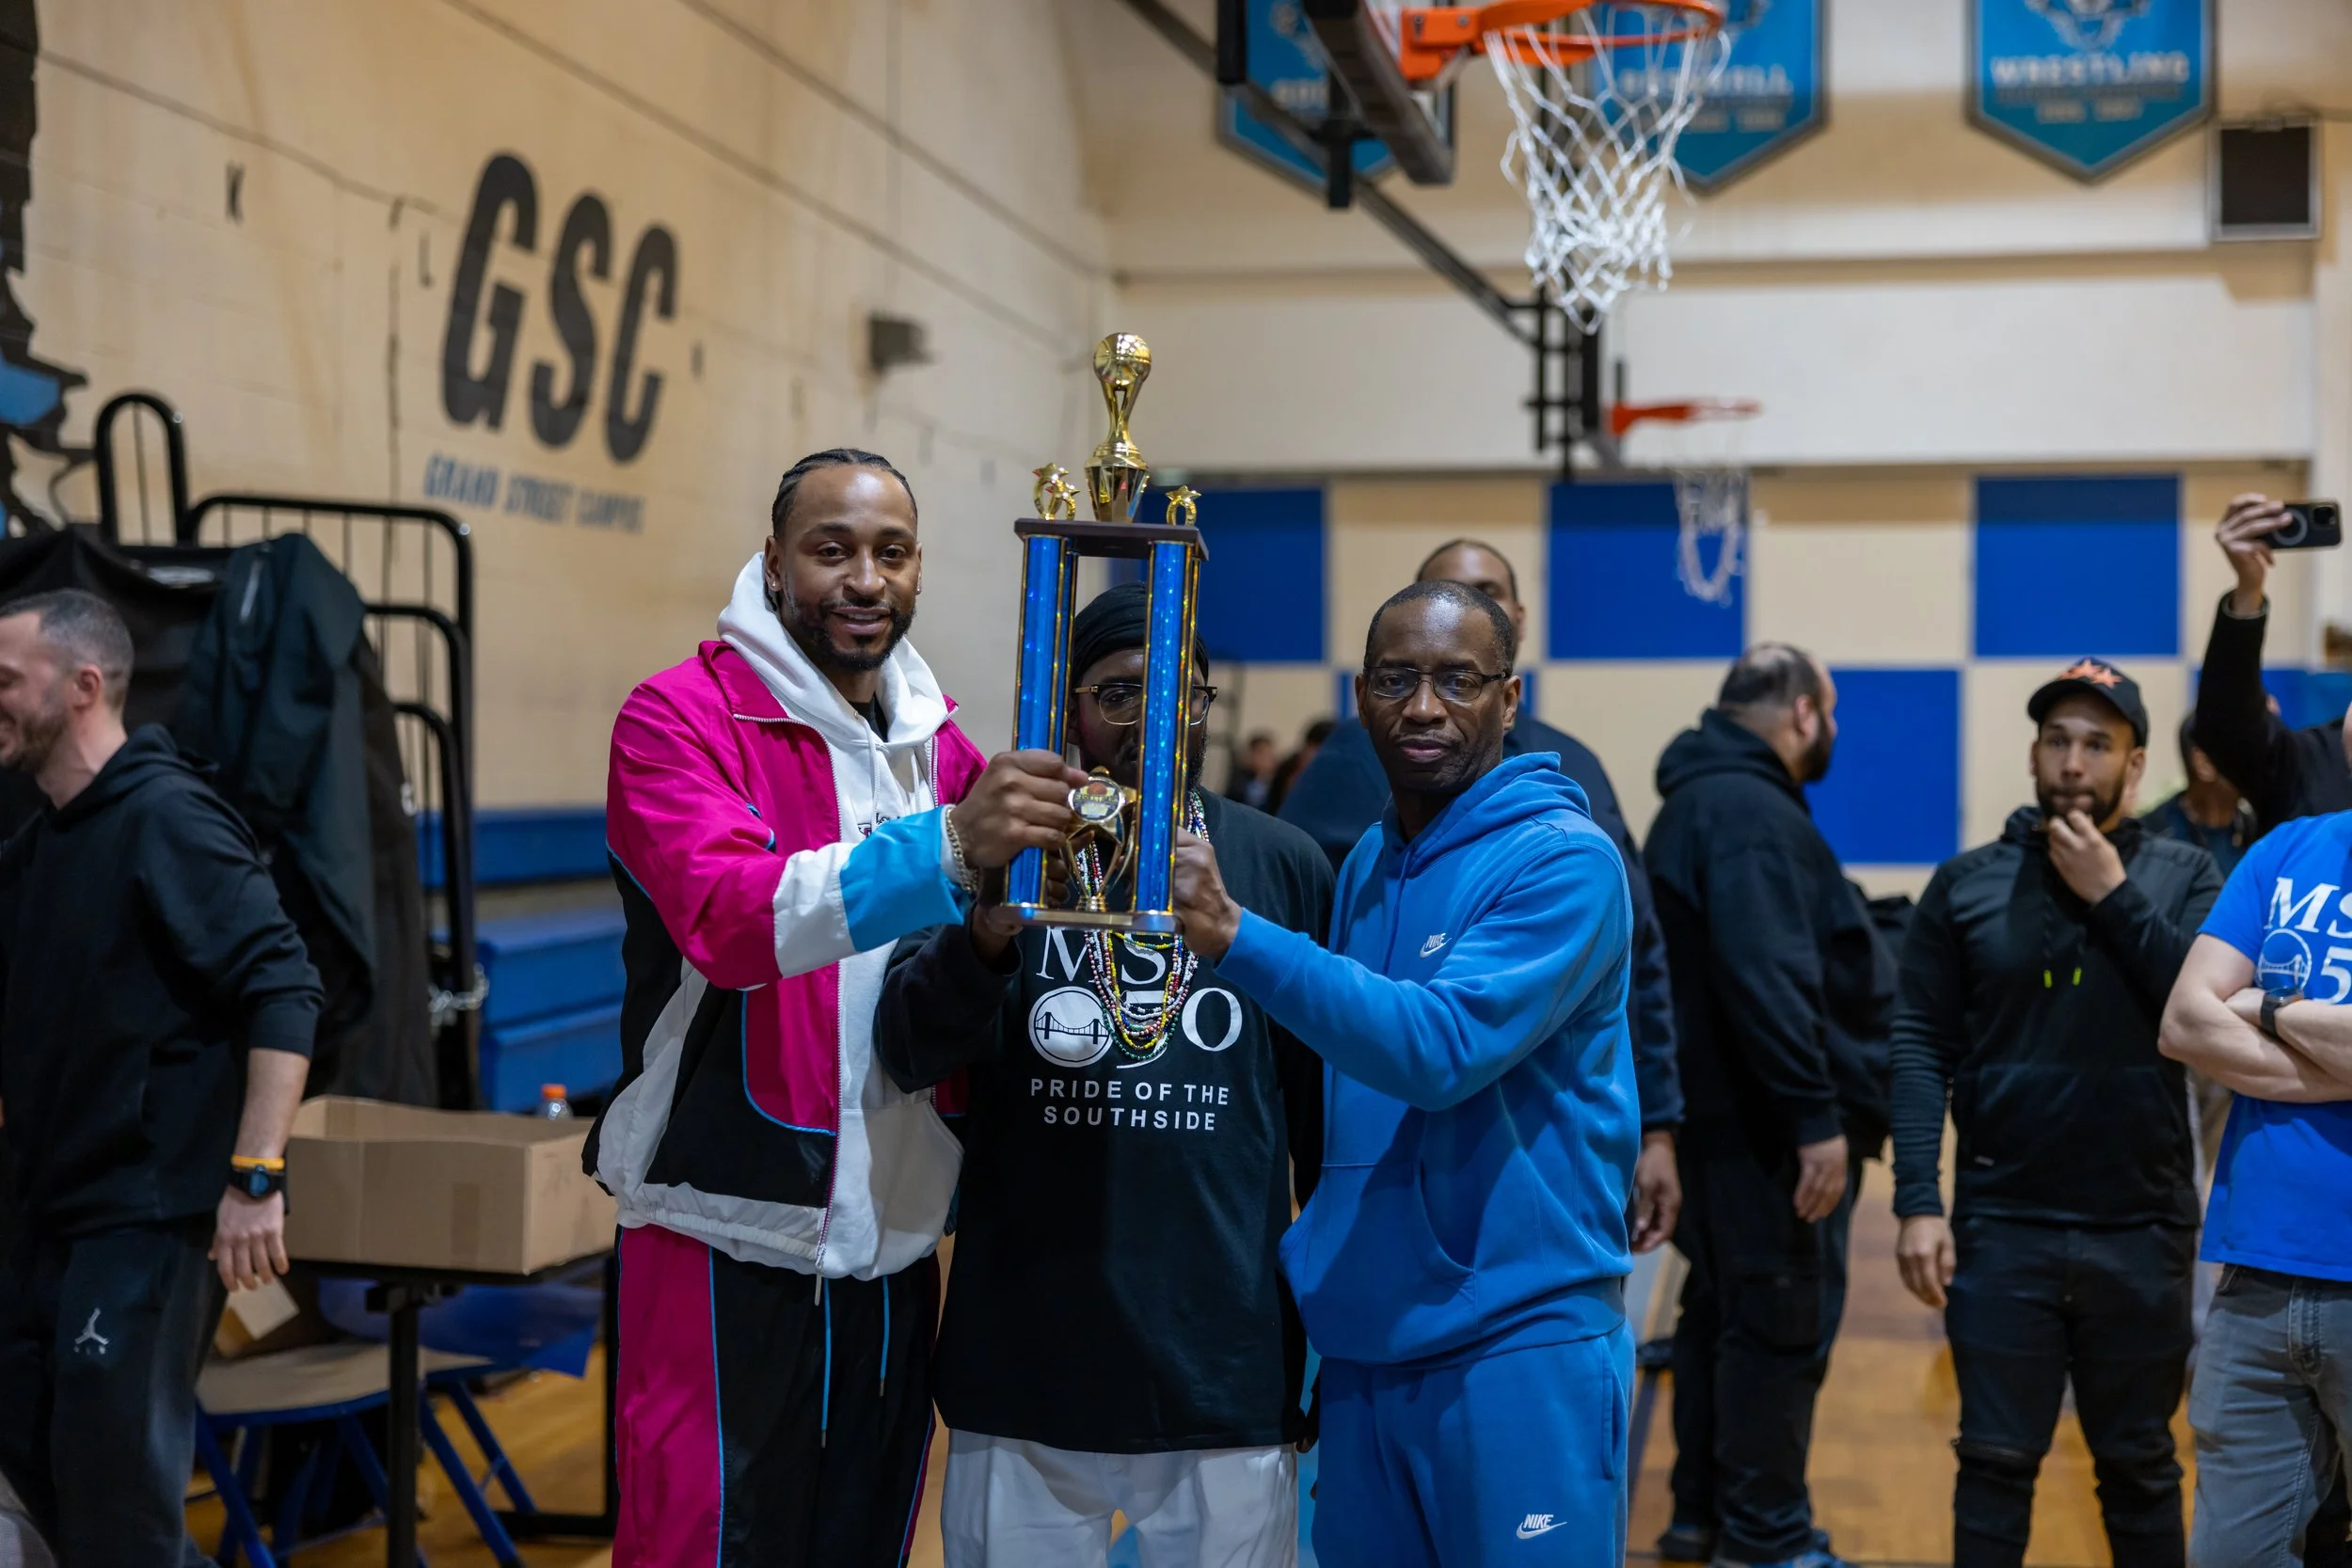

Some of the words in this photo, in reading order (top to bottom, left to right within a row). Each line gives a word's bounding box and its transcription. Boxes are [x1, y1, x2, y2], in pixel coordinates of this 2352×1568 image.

[1991, 52, 2189, 87] WRESTLING
[441, 150, 677, 463] GSC
[1425, 933, 1446, 948] NIKE
[1030, 1078, 1122, 1099] PRIDE
[1135, 1083, 1172, 1101] OF
[1184, 1084, 1229, 1105] THE
[1043, 1105, 1216, 1131] SOUTHSIDE
[1523, 1513, 1554, 1529] NIKE
